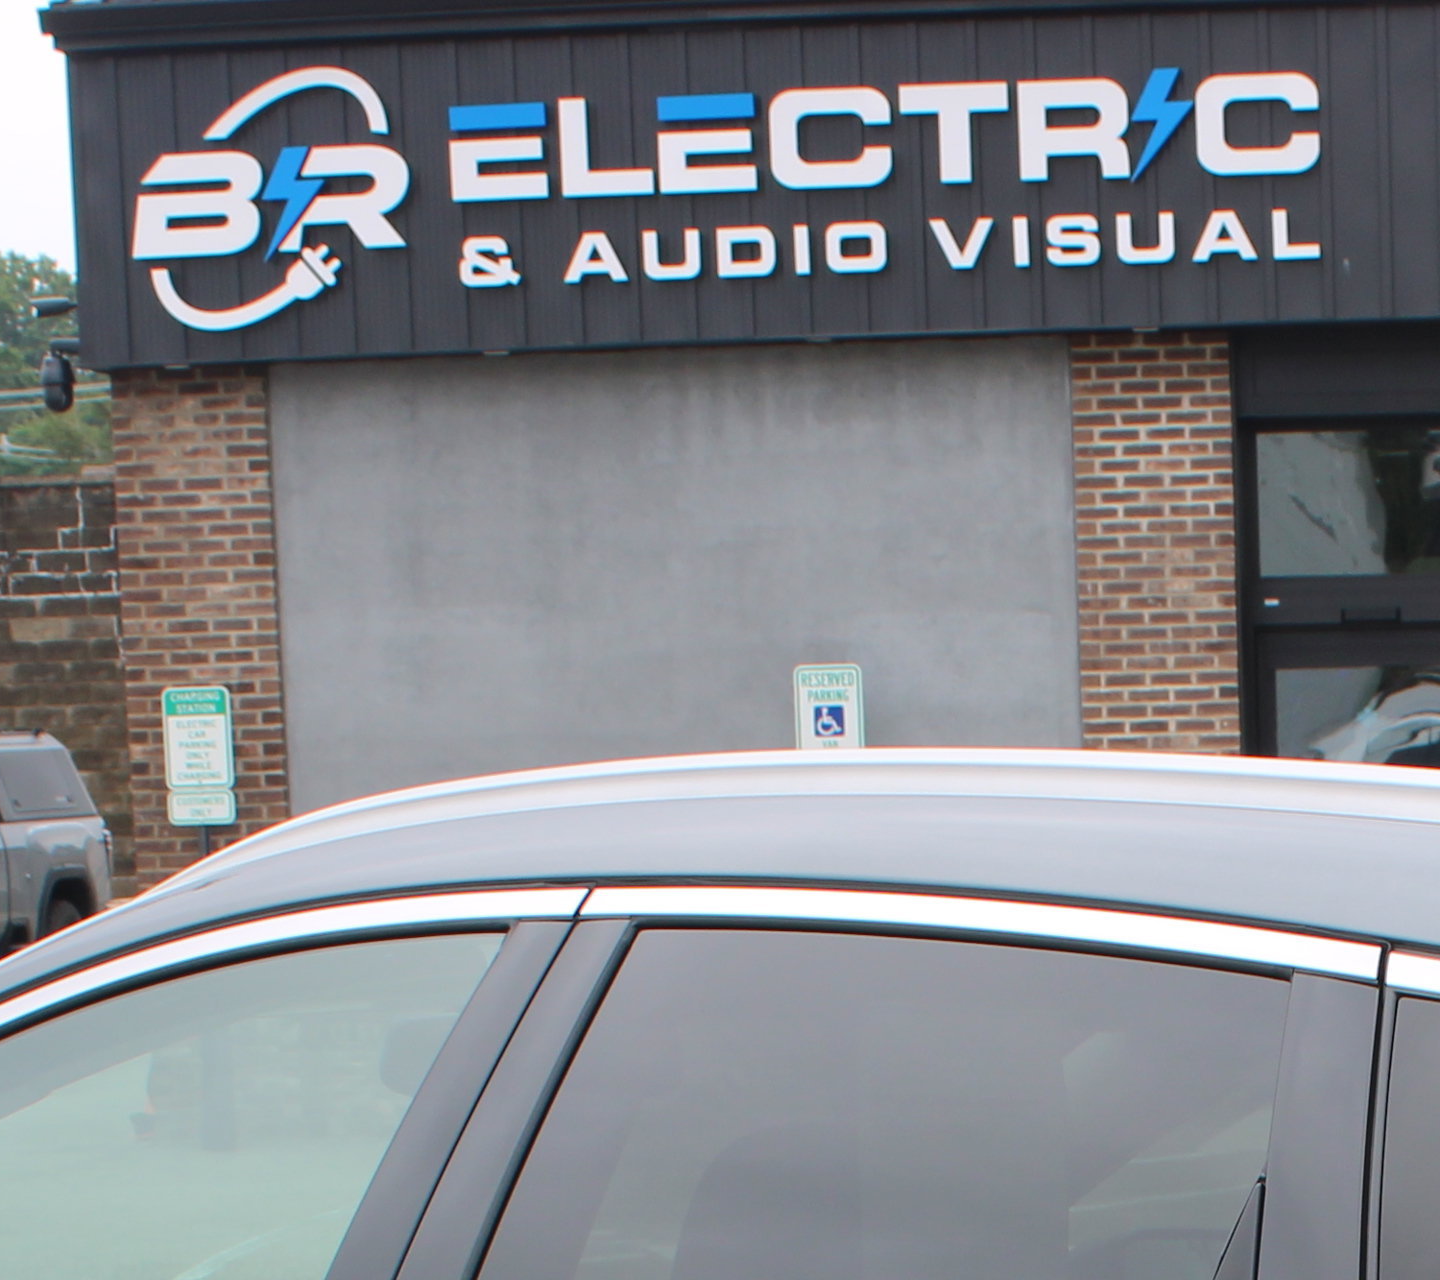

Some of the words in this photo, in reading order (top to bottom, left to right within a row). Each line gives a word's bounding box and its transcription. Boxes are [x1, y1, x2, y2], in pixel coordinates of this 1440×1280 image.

[459, 236, 522, 289] &
[564, 219, 890, 284] AUDIO
[928, 209, 1322, 271] VISUAL
[800, 671, 855, 687] RESERVED
[169, 690, 221, 702] CHARGING
[807, 689, 849, 701] PARKING
[175, 703, 216, 714] STATION
